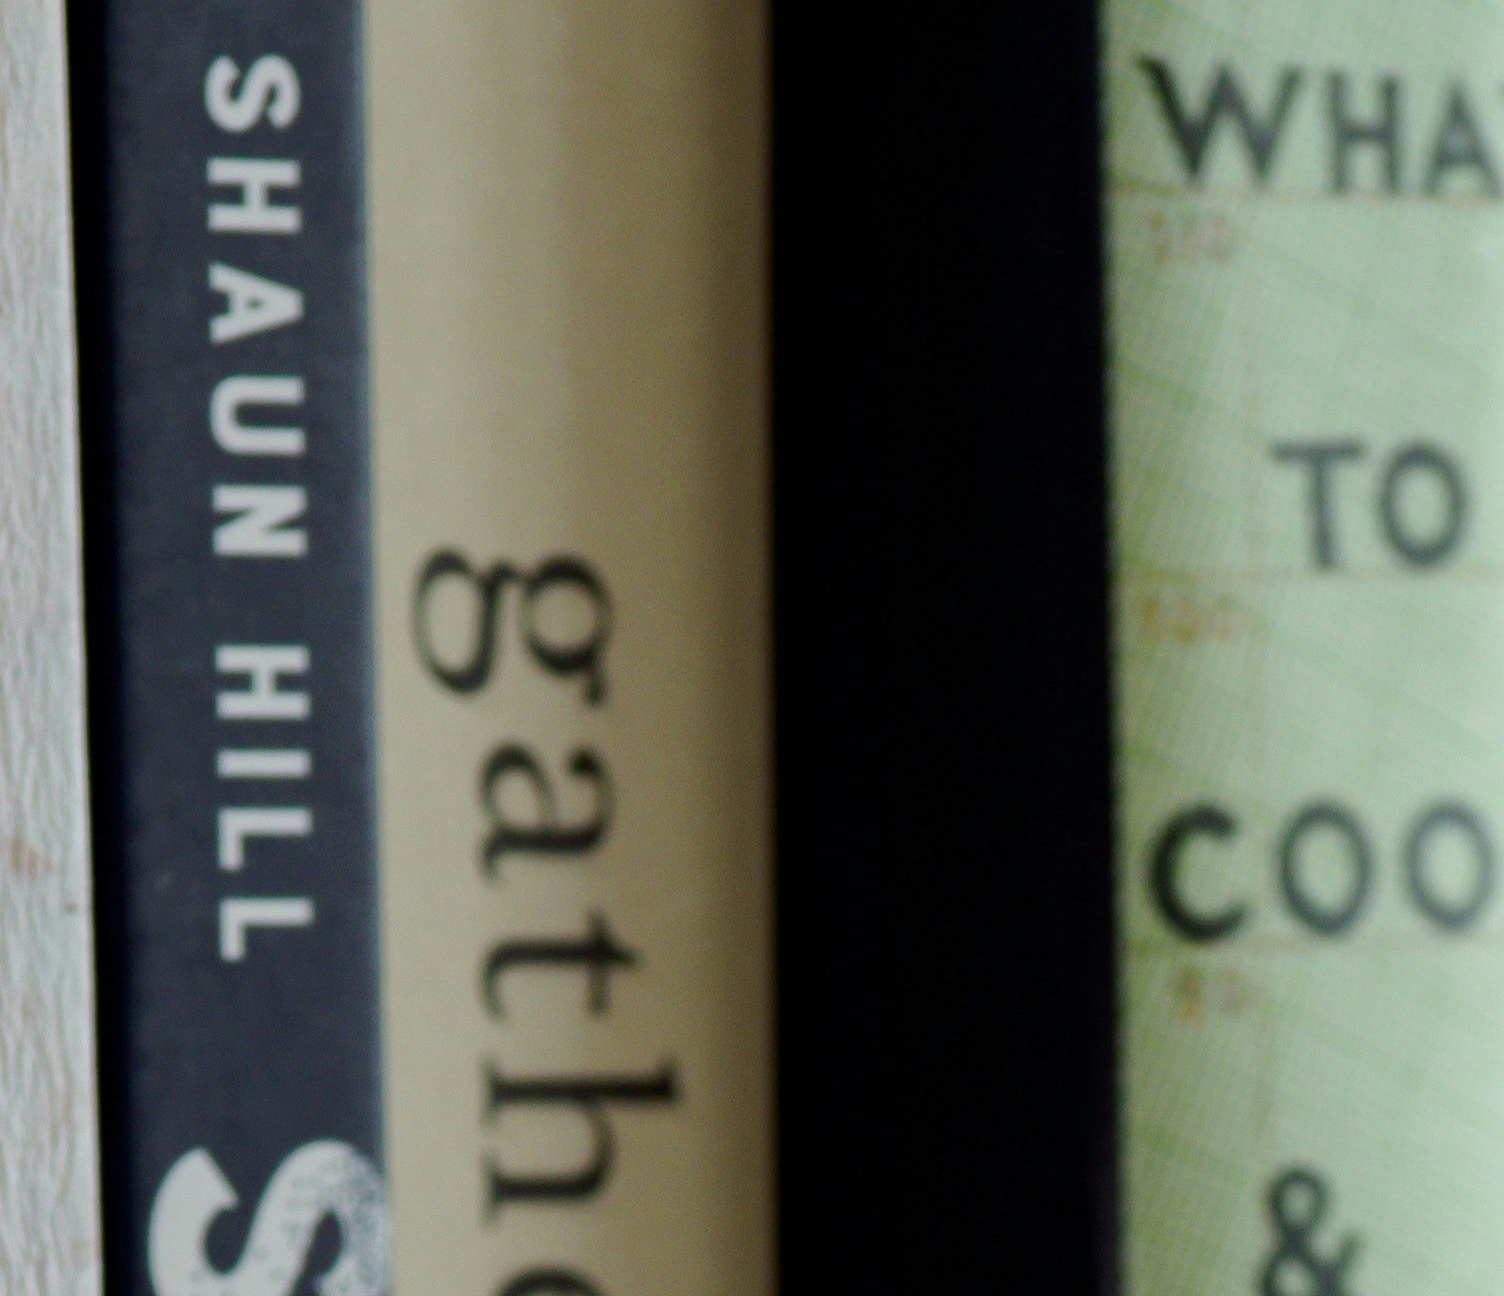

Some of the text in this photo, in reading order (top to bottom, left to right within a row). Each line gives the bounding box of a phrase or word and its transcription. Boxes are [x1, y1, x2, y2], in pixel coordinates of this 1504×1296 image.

[205, 54, 313, 961] SHAUN HILL
[1271, 438, 1472, 572] TO
